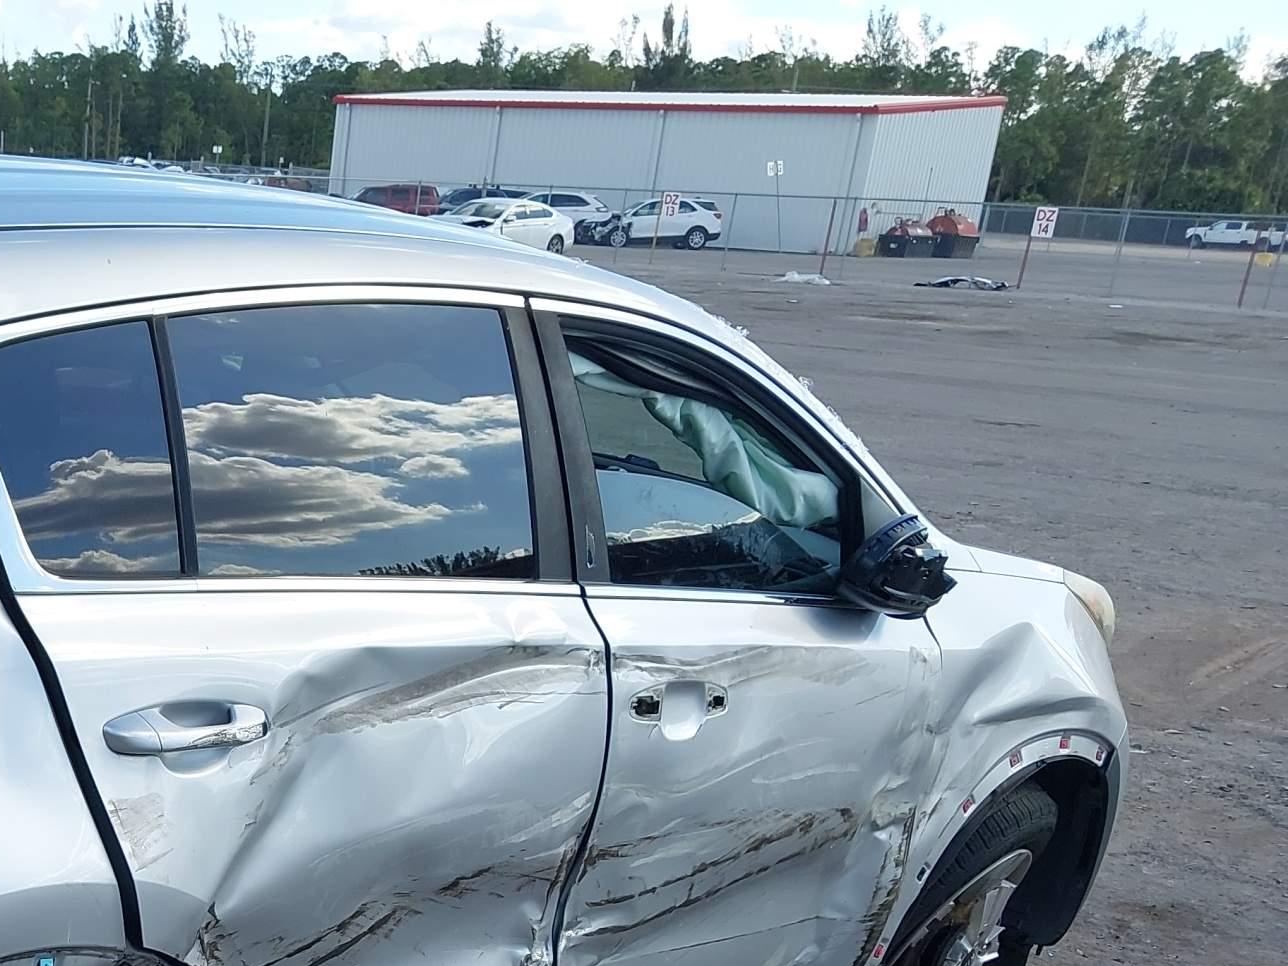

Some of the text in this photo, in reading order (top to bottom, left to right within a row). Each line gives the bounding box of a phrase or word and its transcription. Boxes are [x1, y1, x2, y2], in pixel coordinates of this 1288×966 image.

[664, 194, 680, 205] DZ
[665, 206, 676, 217] 13
[1036, 209, 1057, 222] DZ
[1037, 223, 1050, 235] 14
